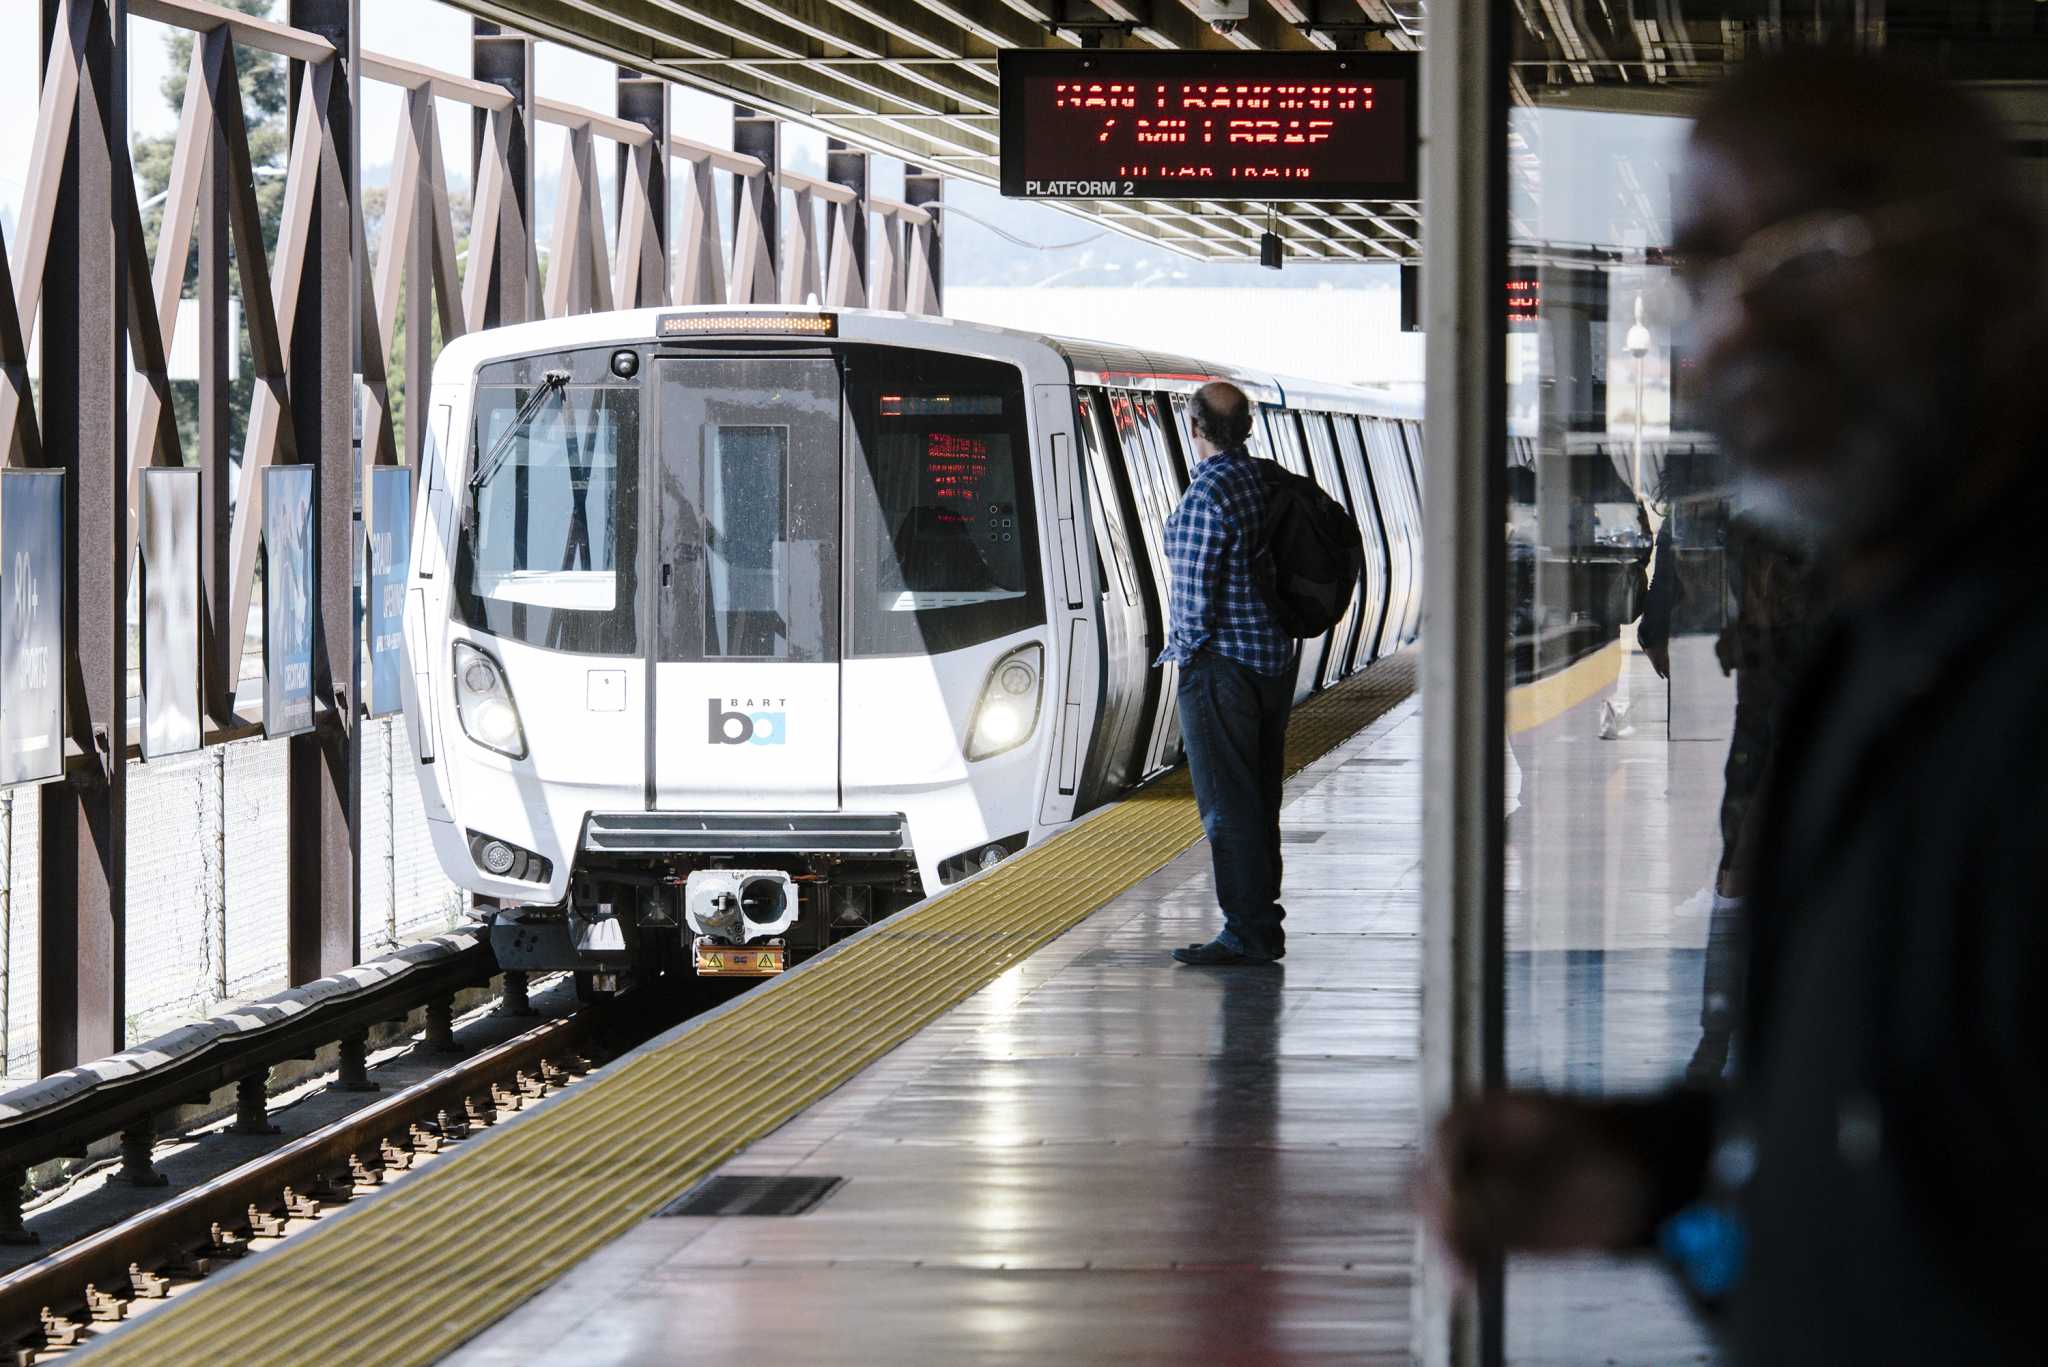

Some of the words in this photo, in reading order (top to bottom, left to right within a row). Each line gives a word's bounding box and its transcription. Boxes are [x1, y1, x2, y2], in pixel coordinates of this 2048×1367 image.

[1025, 181, 1118, 196] PLATFORM
[1120, 181, 1135, 196] 2
[730, 698, 786, 707] BART
